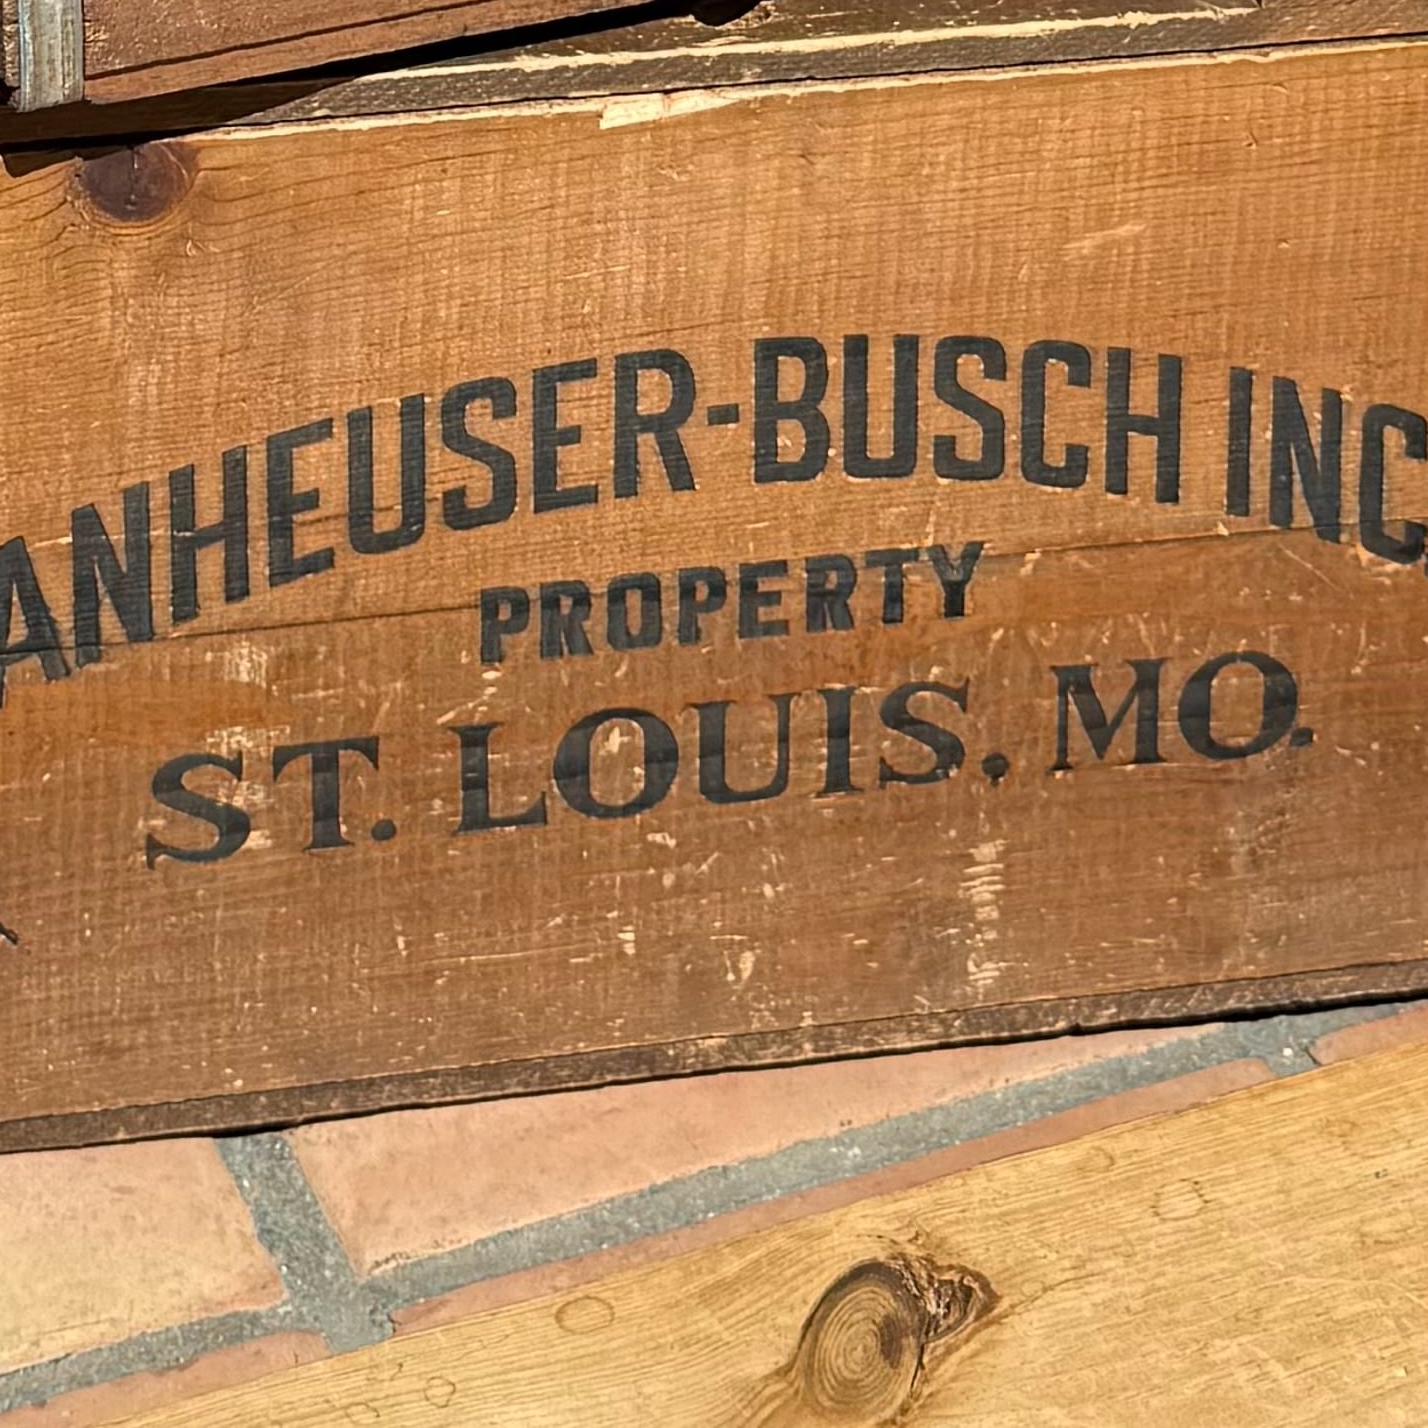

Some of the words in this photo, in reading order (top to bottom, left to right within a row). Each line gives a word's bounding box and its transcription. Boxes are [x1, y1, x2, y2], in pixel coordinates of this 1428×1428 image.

[478, 540, 986, 666] PROPERTY
[144, 734, 398, 871] ST.
[1045, 647, 1316, 775] MO.
